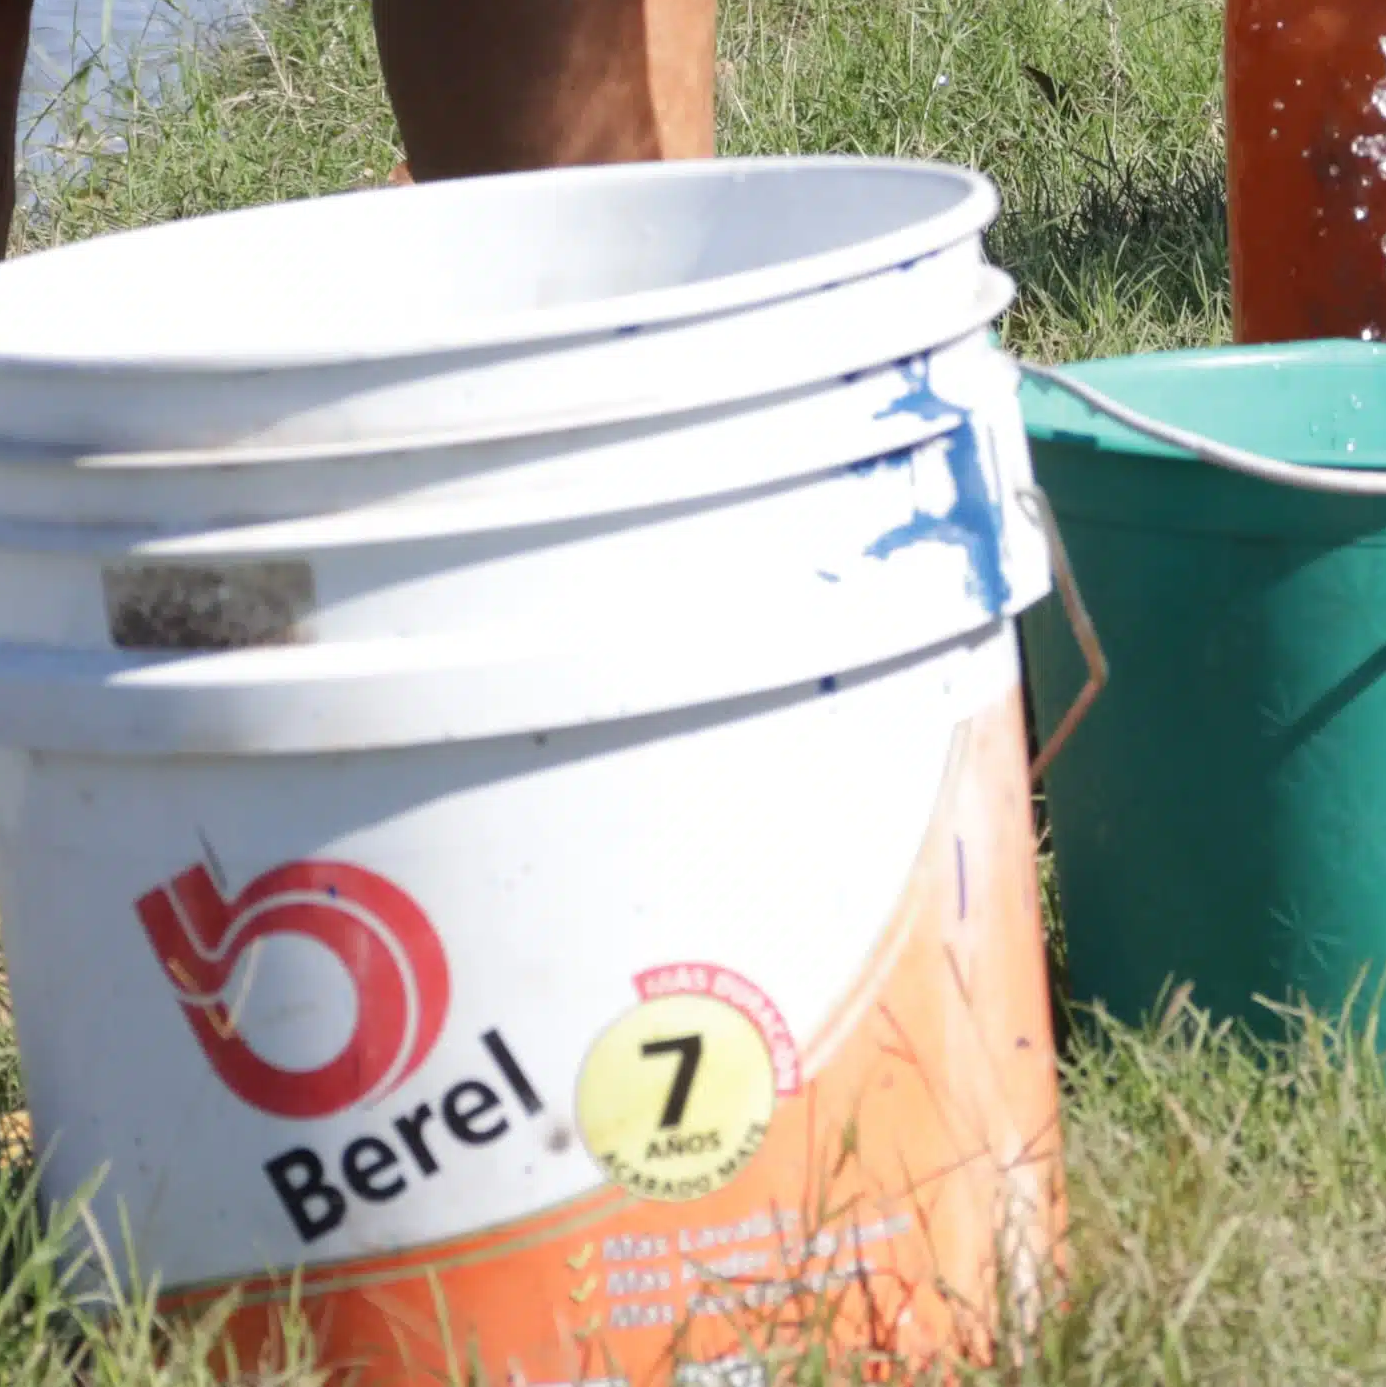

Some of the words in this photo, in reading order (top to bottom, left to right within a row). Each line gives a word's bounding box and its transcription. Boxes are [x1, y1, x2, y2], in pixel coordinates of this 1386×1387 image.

[642, 1033, 703, 1129] 7
[265, 1027, 544, 1244] Berel
[645, 1128, 721, 1160] AÑOS
[601, 1151, 712, 1196] ACABADO
